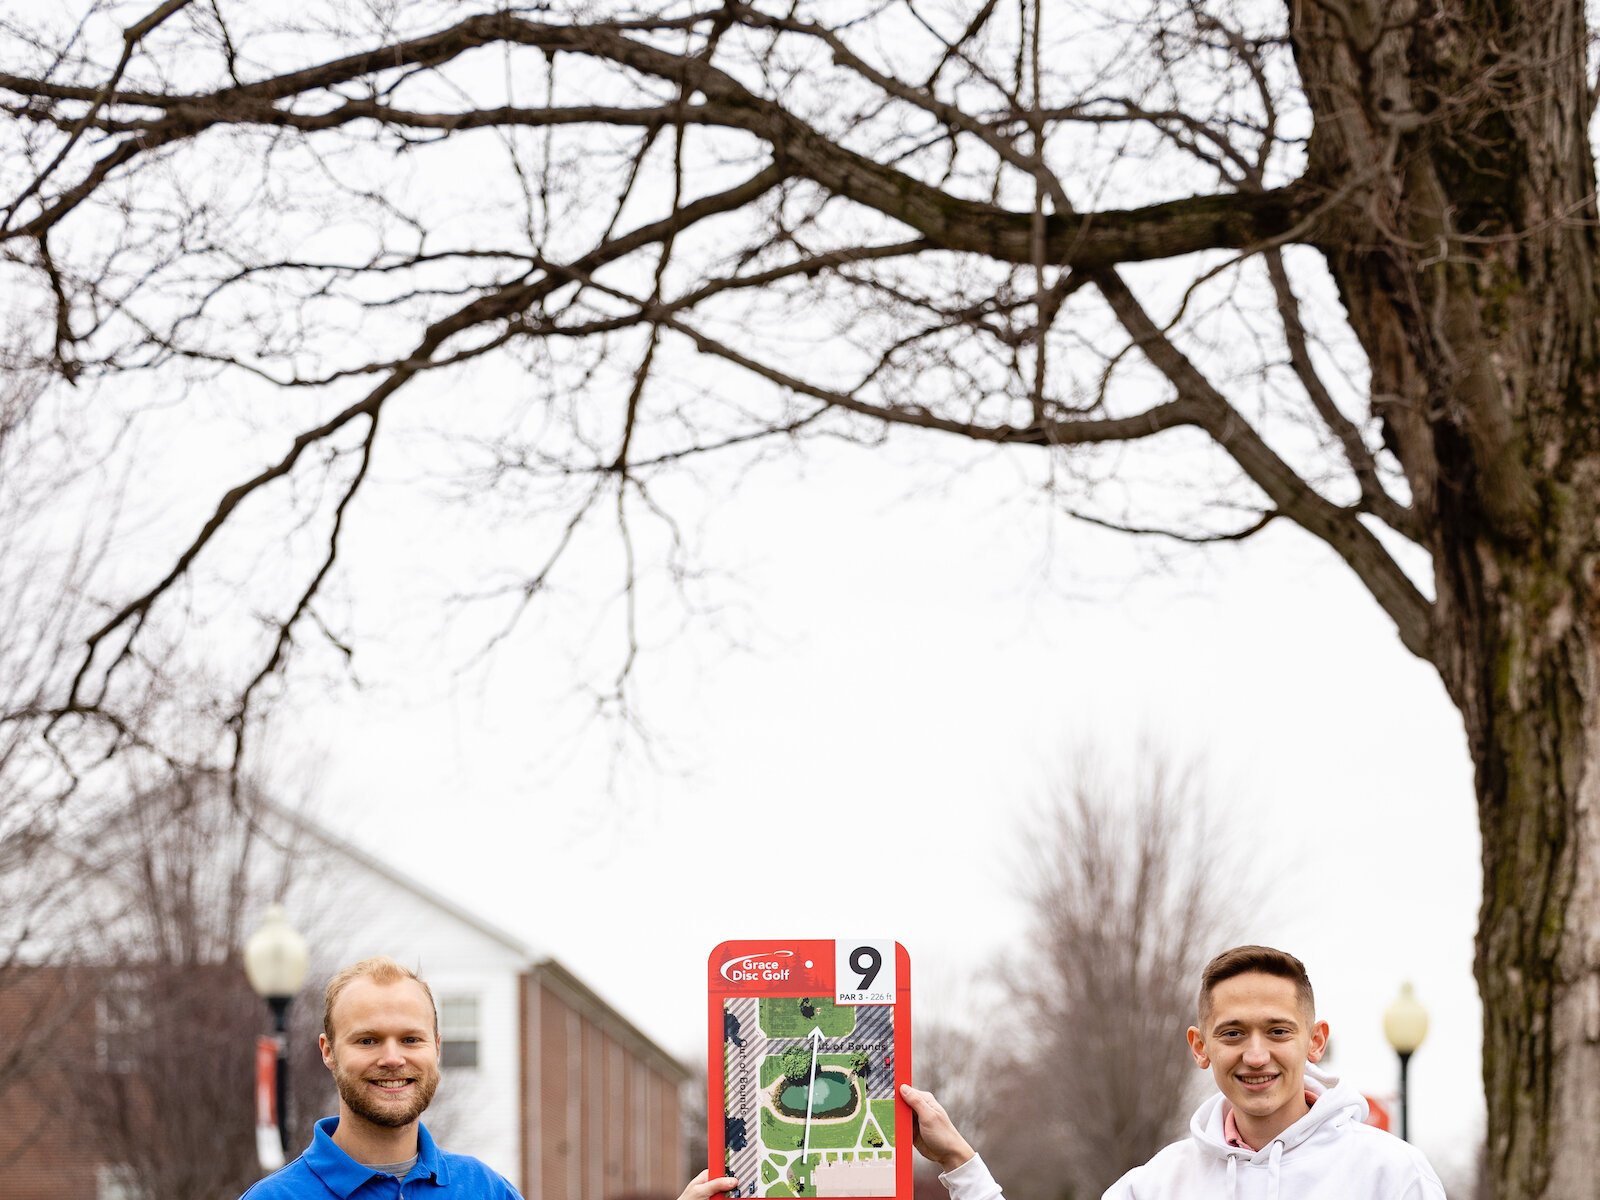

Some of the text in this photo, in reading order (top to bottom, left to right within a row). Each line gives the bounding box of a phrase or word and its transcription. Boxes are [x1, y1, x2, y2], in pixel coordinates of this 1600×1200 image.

[742, 959, 779, 970] Grace
[849, 946, 882, 990] 9
[732, 970, 790, 980] Disc Golf
[886, 992, 892, 1001] ft
[833, 1042, 844, 1051] of
[847, 1042, 886, 1051] Bounds
[740, 1039, 748, 1115] Out of Bounds
